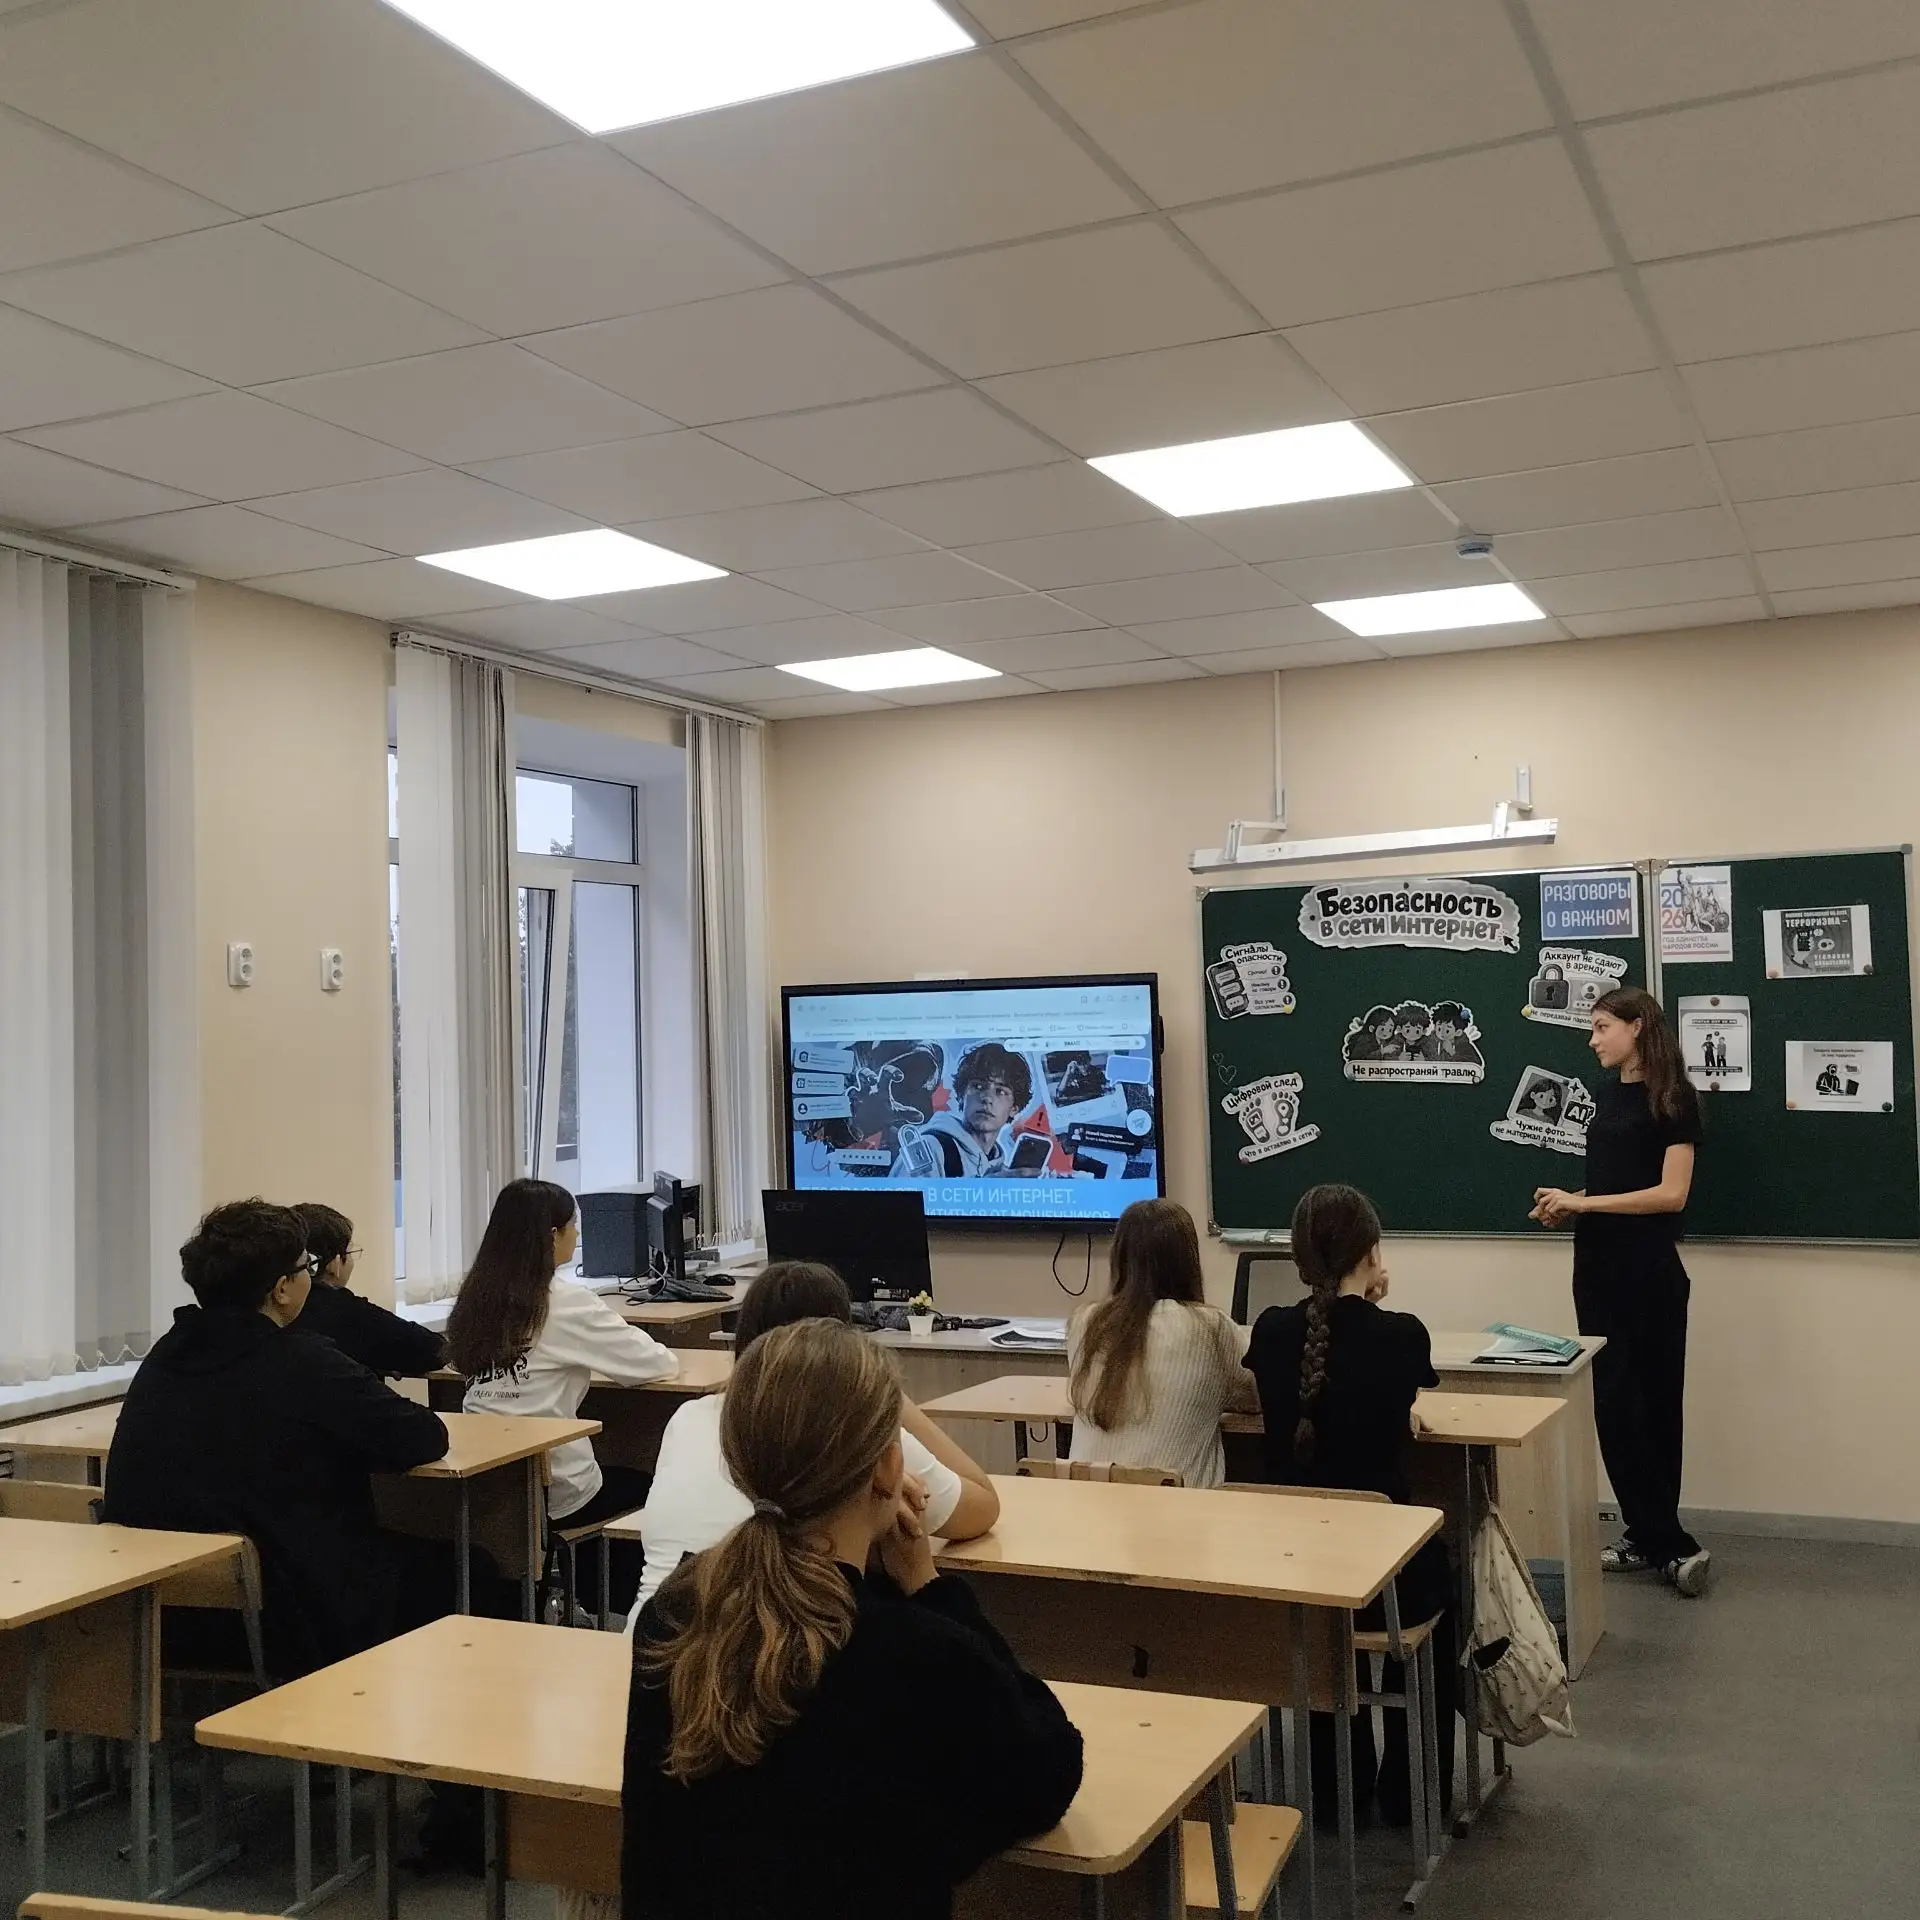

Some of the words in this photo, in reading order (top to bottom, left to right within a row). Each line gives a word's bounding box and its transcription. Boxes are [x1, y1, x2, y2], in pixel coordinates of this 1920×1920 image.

[1544, 882, 1631, 902] РАЗГОВОРЫ
[1661, 888, 1683, 908] 20
[1316, 887, 1502, 918] Безопасность
[1546, 911, 1557, 928] О
[1561, 908, 1630, 928] ВАЖНОМ
[1661, 909, 1684, 929] 26
[1785, 917, 1841, 928] ТЕРРОРИЗМА
[1320, 919, 1333, 938] в
[1338, 917, 1385, 937] сети
[1390, 915, 1500, 941] Интернет
[1225, 945, 1269, 959] Сигналы
[1236, 954, 1283, 965] опасности
[1544, 952, 1580, 962] Аккаунт
[1582, 955, 1593, 963] не
[1594, 958, 1622, 970] сдают
[1573, 963, 1606, 977] аренду
[1352, 1064, 1366, 1075] Не
[1368, 1065, 1439, 1078] распространяй
[1441, 1068, 1476, 1078] травлю
[1226, 1081, 1272, 1109] Цифровой
[1274, 1078, 1298, 1088] след
[1505, 1129, 1541, 1141] материал
[1542, 1135, 1556, 1145] для
[1515, 1120, 1543, 1133] Чужие
[1544, 1126, 1566, 1137] фото
[927, 1187, 938, 1202] В
[941, 1187, 984, 1203] СЕТИ
[988, 1187, 1077, 1204] ИНТЕРНЕТ.
